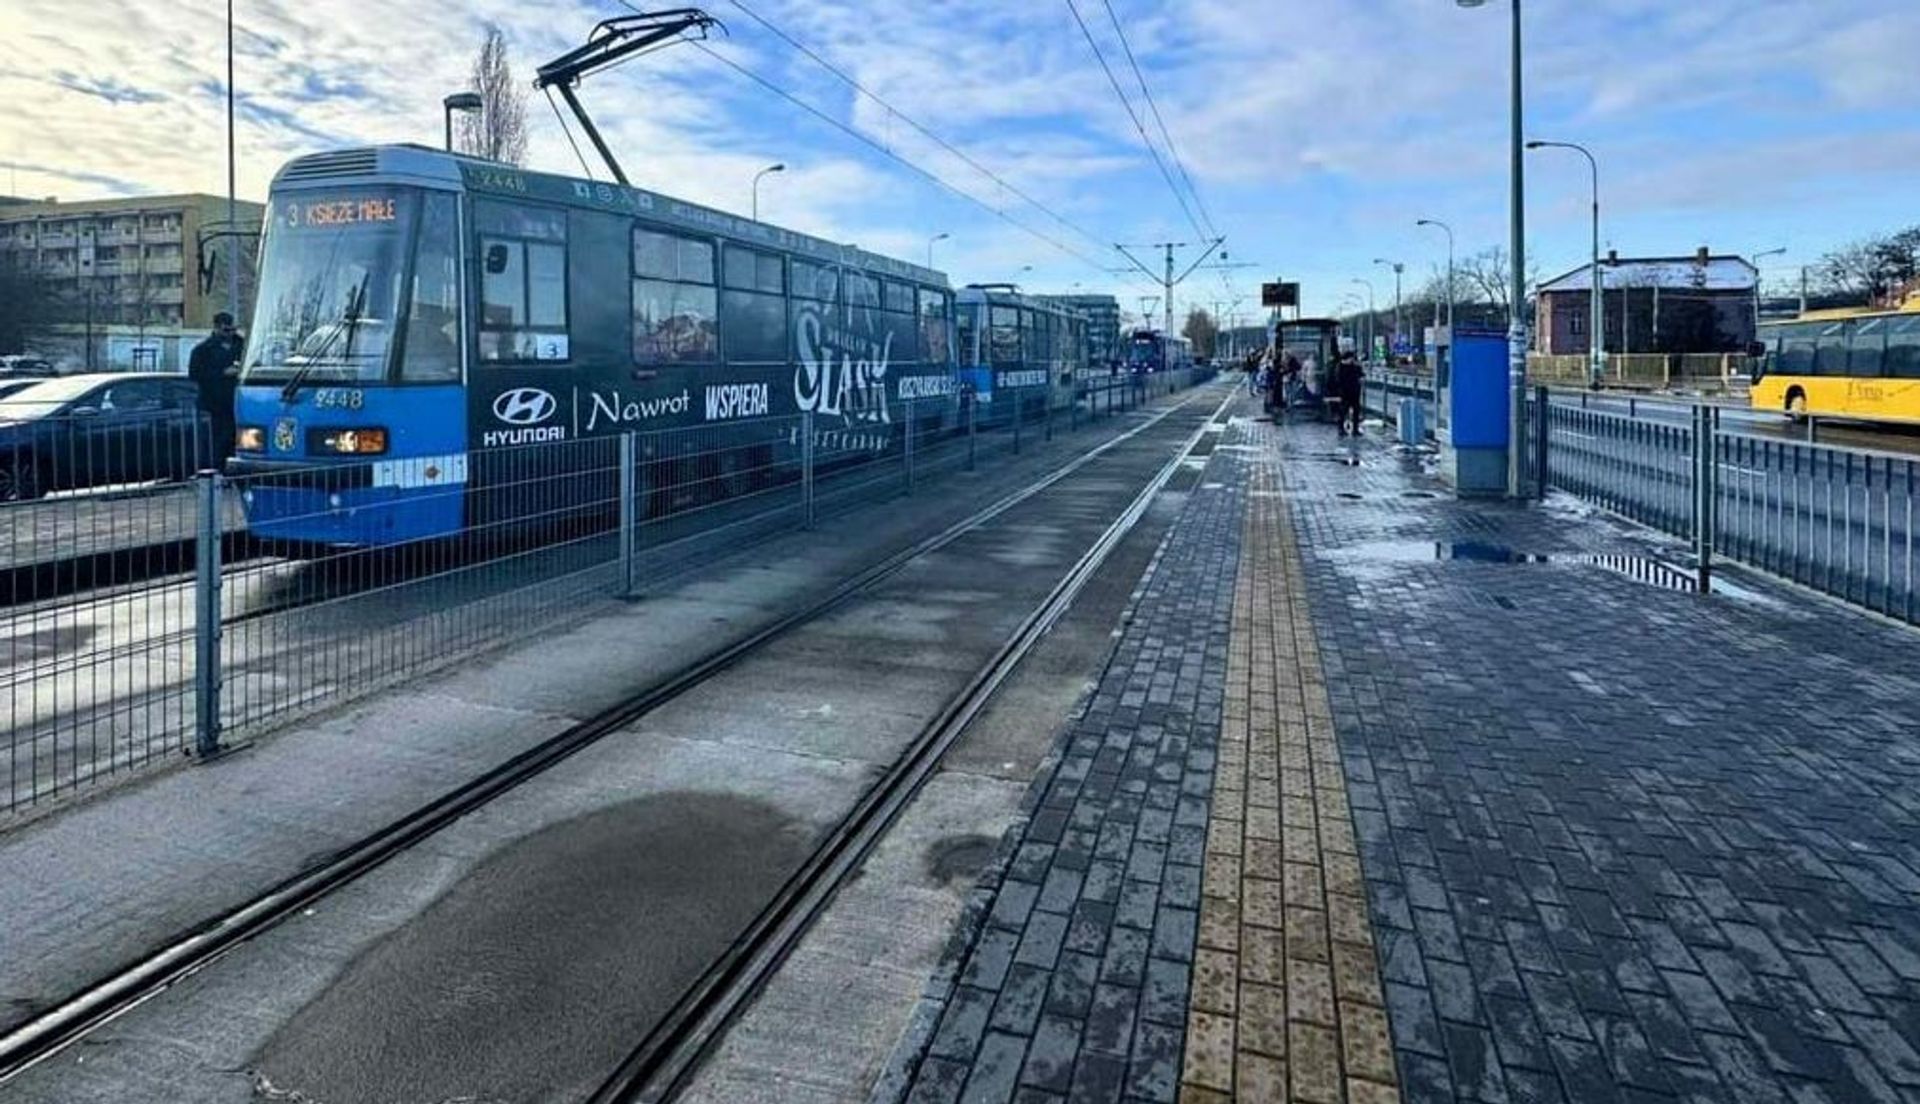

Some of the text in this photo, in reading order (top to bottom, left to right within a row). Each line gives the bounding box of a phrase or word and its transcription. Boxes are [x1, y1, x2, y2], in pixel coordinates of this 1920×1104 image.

[287, 203, 298, 227] 3
[546, 341, 558, 357] 3
[316, 389, 363, 408] 2448
[586, 388, 691, 431] Nawrot
[705, 383, 769, 420] WSPIERA
[484, 426, 565, 447] HYUNDAI
